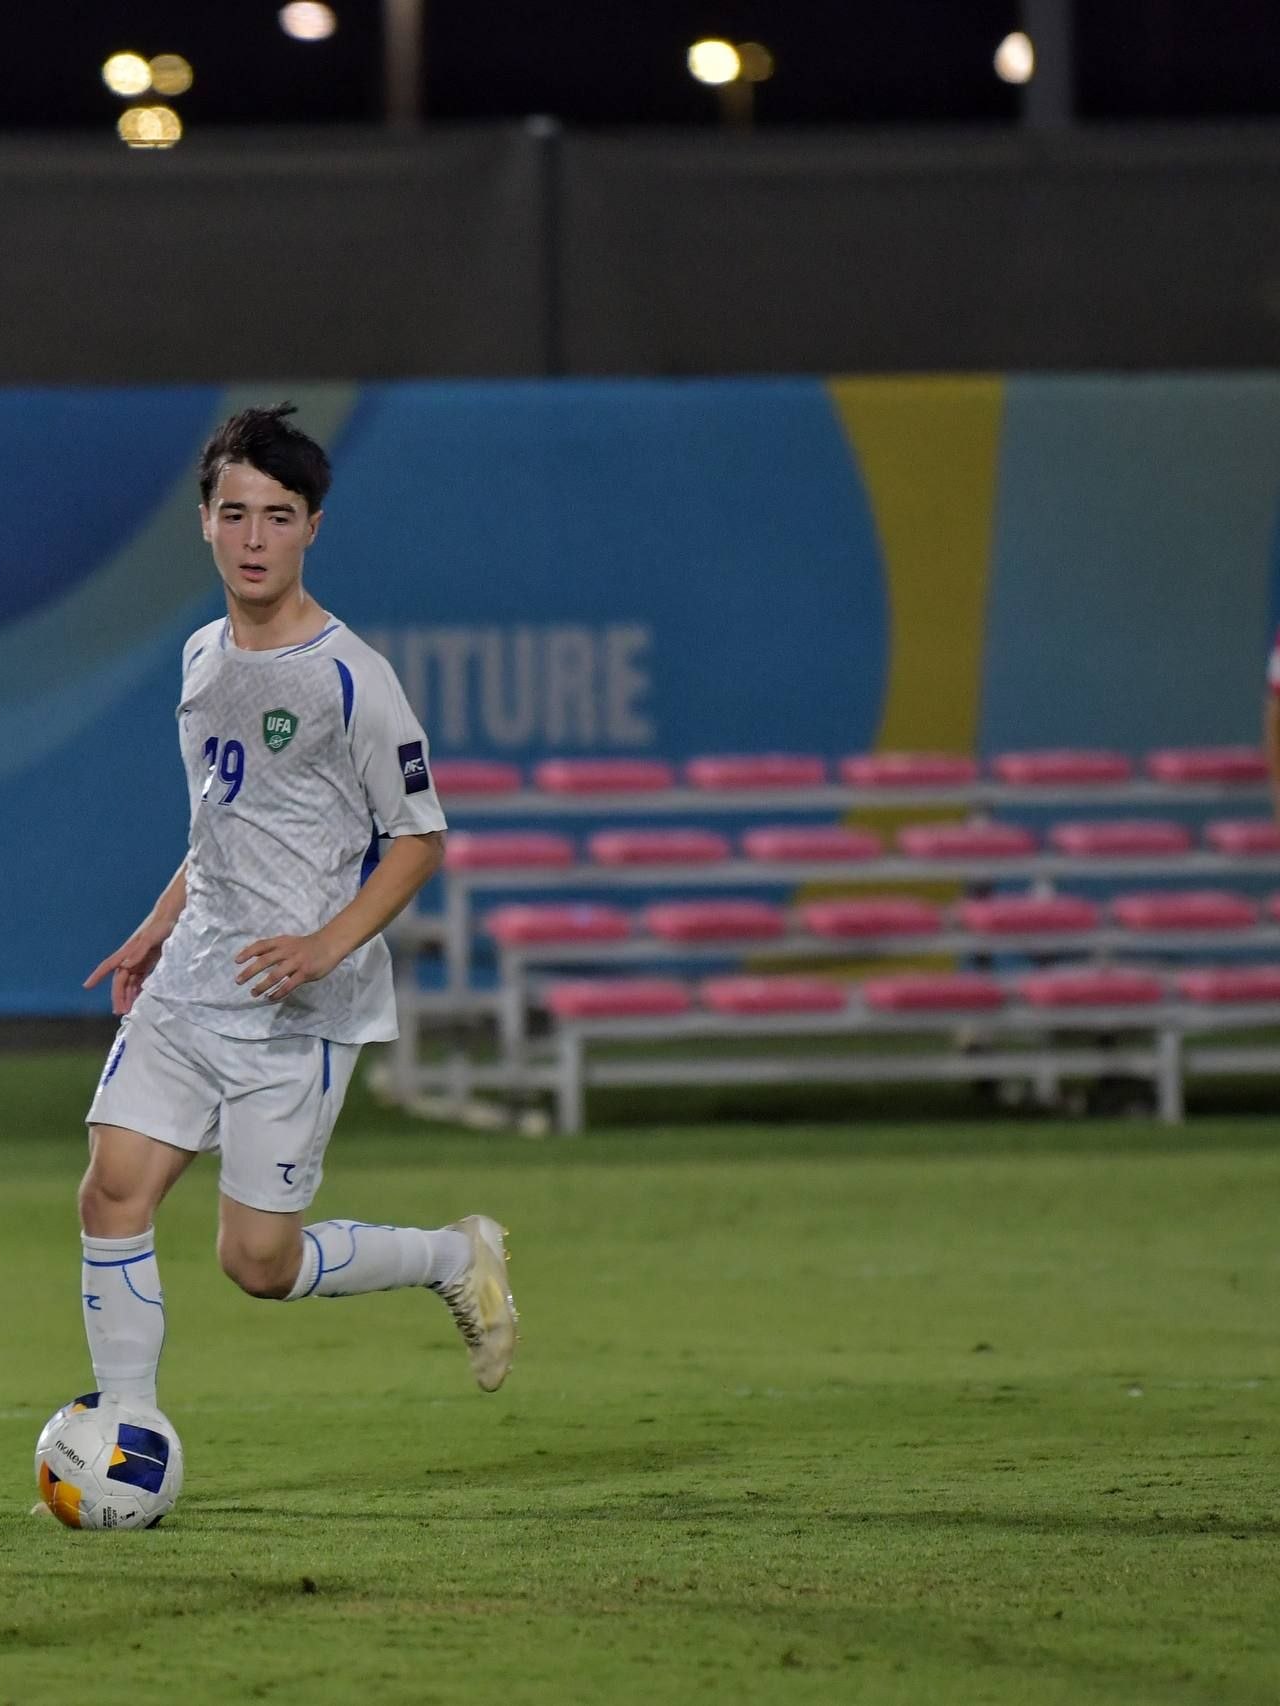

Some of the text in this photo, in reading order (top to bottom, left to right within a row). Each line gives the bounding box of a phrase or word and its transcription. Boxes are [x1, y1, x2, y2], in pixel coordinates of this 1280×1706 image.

[266, 716, 291, 734] UFA
[200, 736, 245, 806] 19
[404, 757, 424, 775] AFC
[55, 1439, 86, 1470] molten
